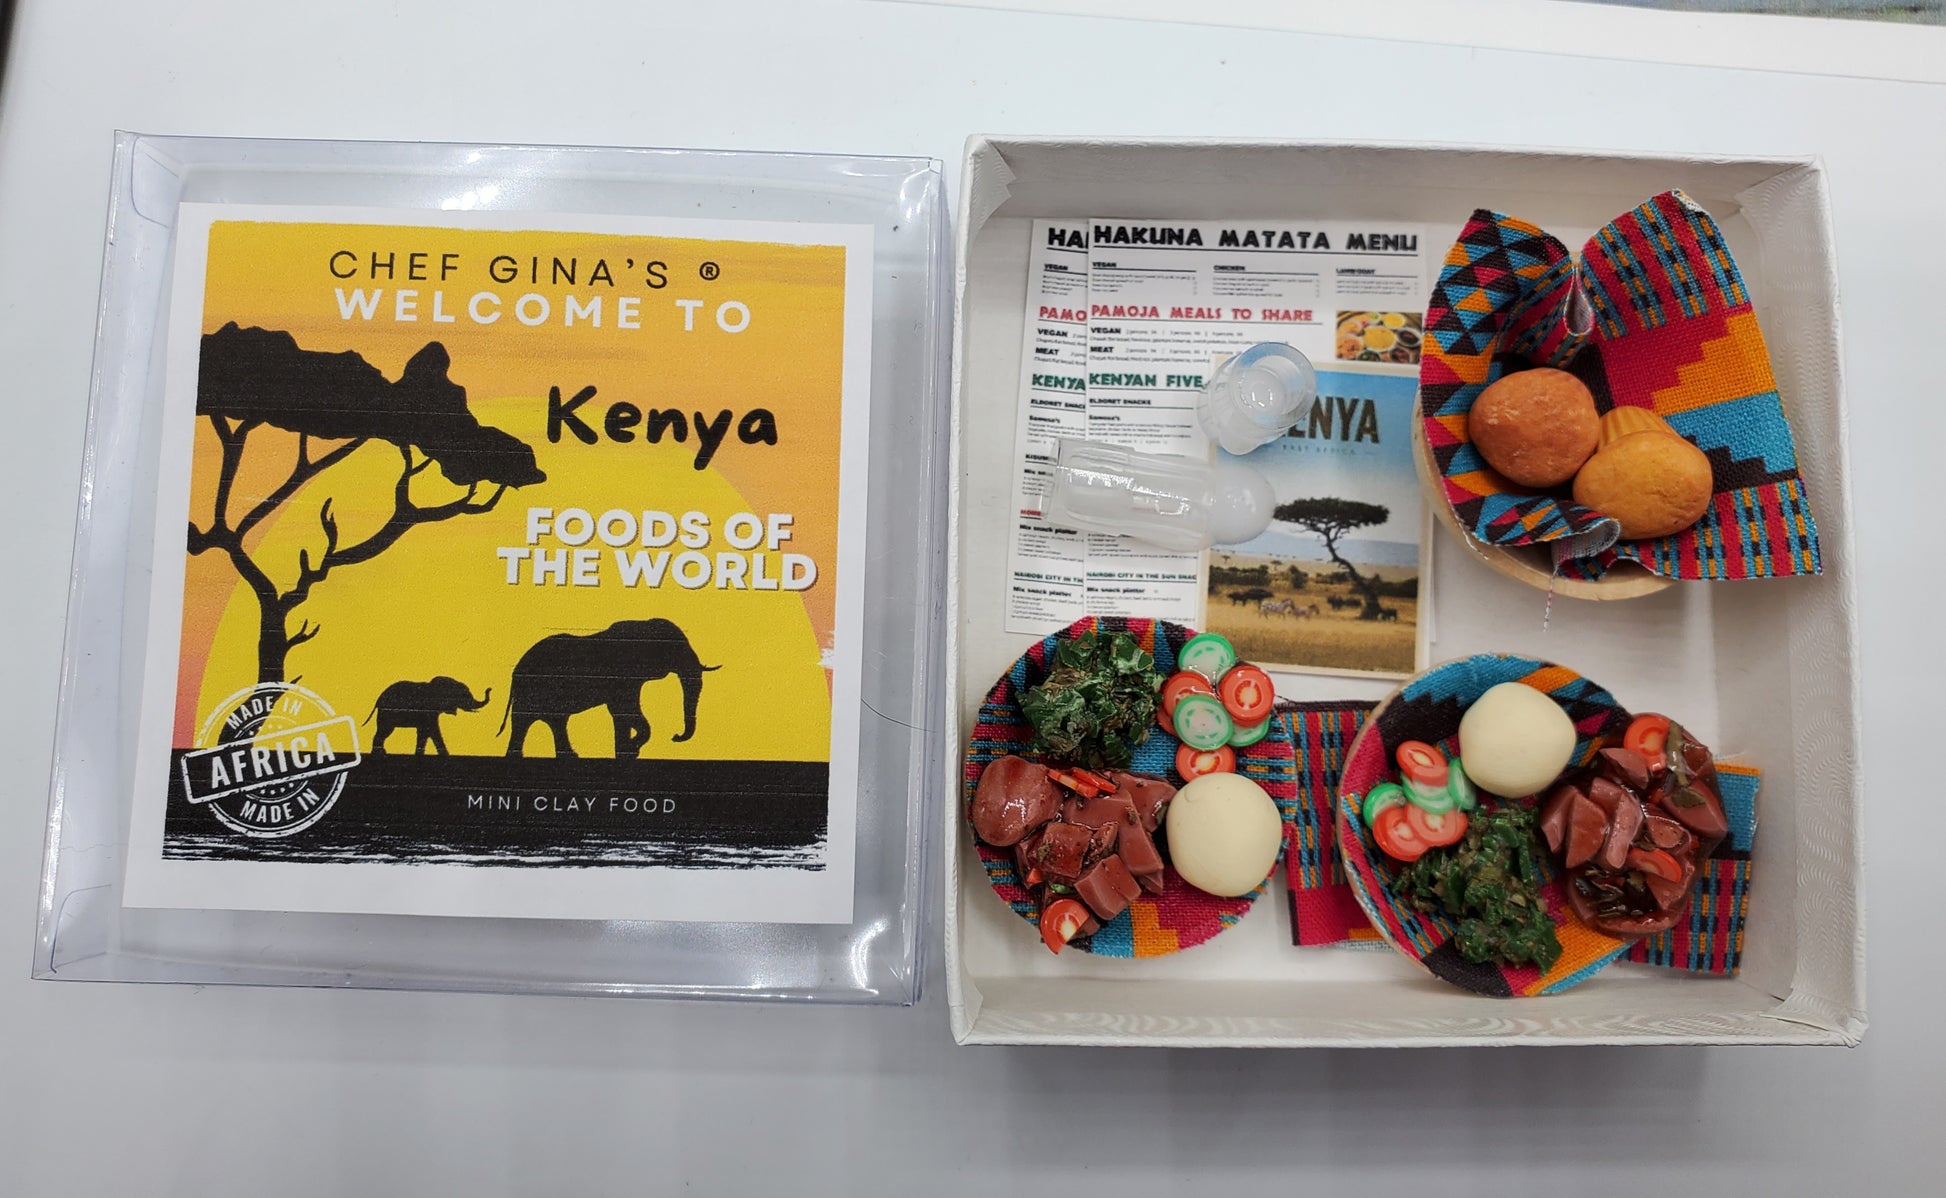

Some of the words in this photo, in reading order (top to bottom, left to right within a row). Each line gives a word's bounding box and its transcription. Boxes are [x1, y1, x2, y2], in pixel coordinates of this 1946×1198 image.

[1048, 228, 1088, 249] HA
[1094, 225, 1203, 247] HAKUNA
[1218, 229, 1331, 250] MATATA
[1346, 232, 1418, 252] MENU
[330, 250, 460, 281] CHEF
[489, 255, 669, 289] GINA'S
[335, 287, 641, 330] WELCOME
[676, 299, 751, 334] TO
[1091, 304, 1160, 319] PAMOJA
[1170, 306, 1222, 320] MEALS
[1232, 308, 1252, 320] TO
[1261, 308, 1314, 322] SHARE
[1037, 327, 1068, 338] VEGAN
[1090, 326, 1121, 335] VEGAN
[1035, 346, 1060, 356] MEAT
[1089, 346, 1115, 354] MEAT
[1088, 373, 1157, 387] KENYAN
[547, 385, 778, 471] Kenya
[526, 507, 710, 550] FOODS
[724, 512, 795, 550] OF
[497, 547, 601, 587] THE
[614, 550, 819, 591] WORLD
[226, 695, 275, 731] MADE
[282, 697, 303, 716] IN
[211, 732, 336, 789] AFRICA
[240, 800, 294, 824] MADE
[297, 787, 321, 812] IN
[467, 794, 520, 812] MINI
[534, 796, 597, 813] CLAY
[609, 797, 676, 814] FOOD
